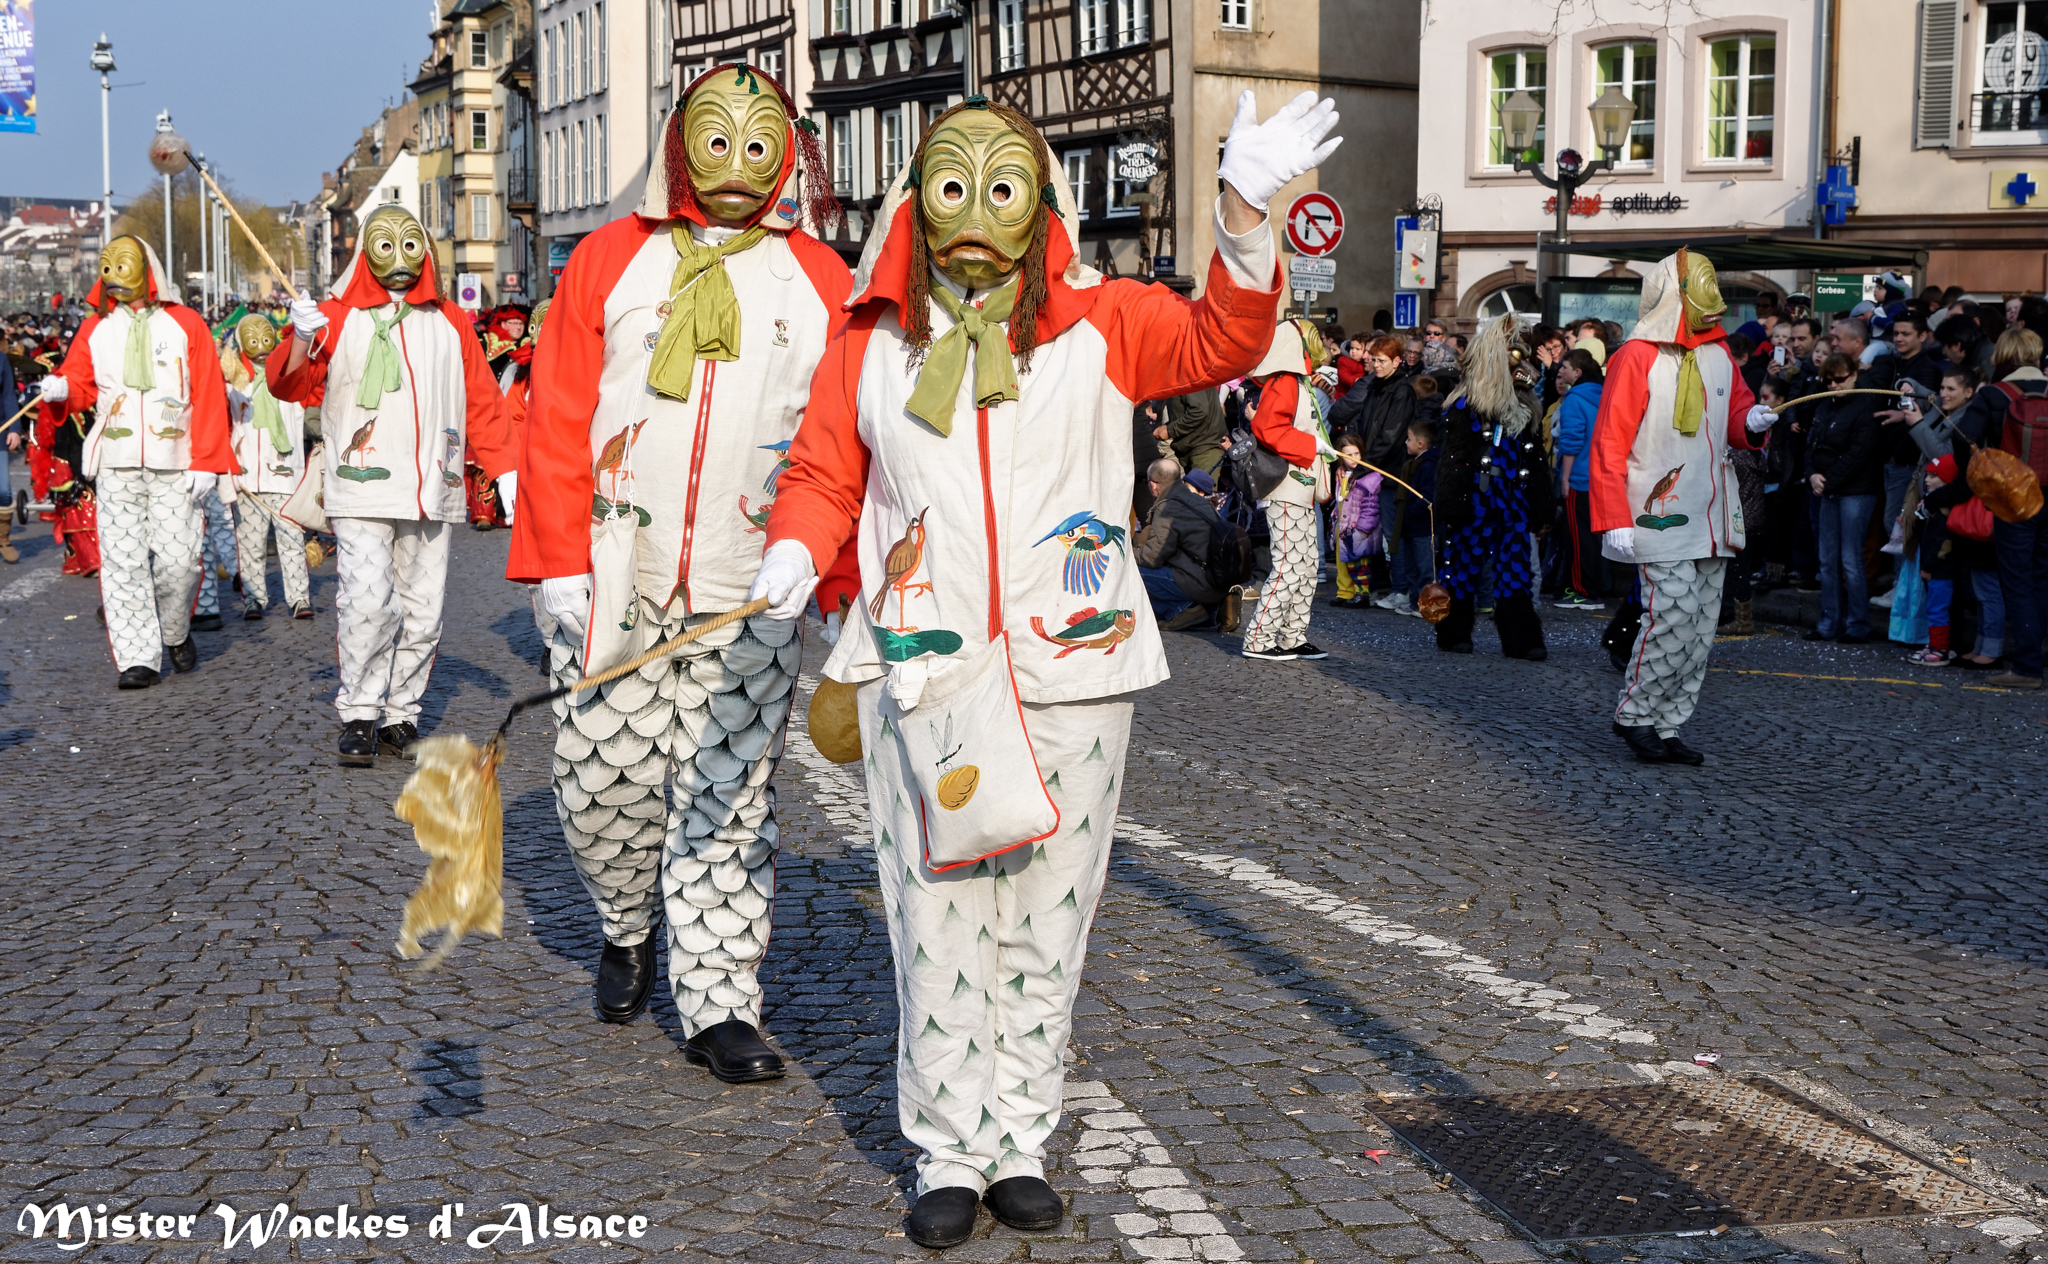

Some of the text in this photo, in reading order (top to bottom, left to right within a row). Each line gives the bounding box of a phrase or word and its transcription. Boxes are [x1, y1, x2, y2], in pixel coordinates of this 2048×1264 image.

[1127, 157, 1151, 168] TROIS
[1612, 192, 1682, 214] aptitude
[1817, 286, 1846, 294] Corbeau
